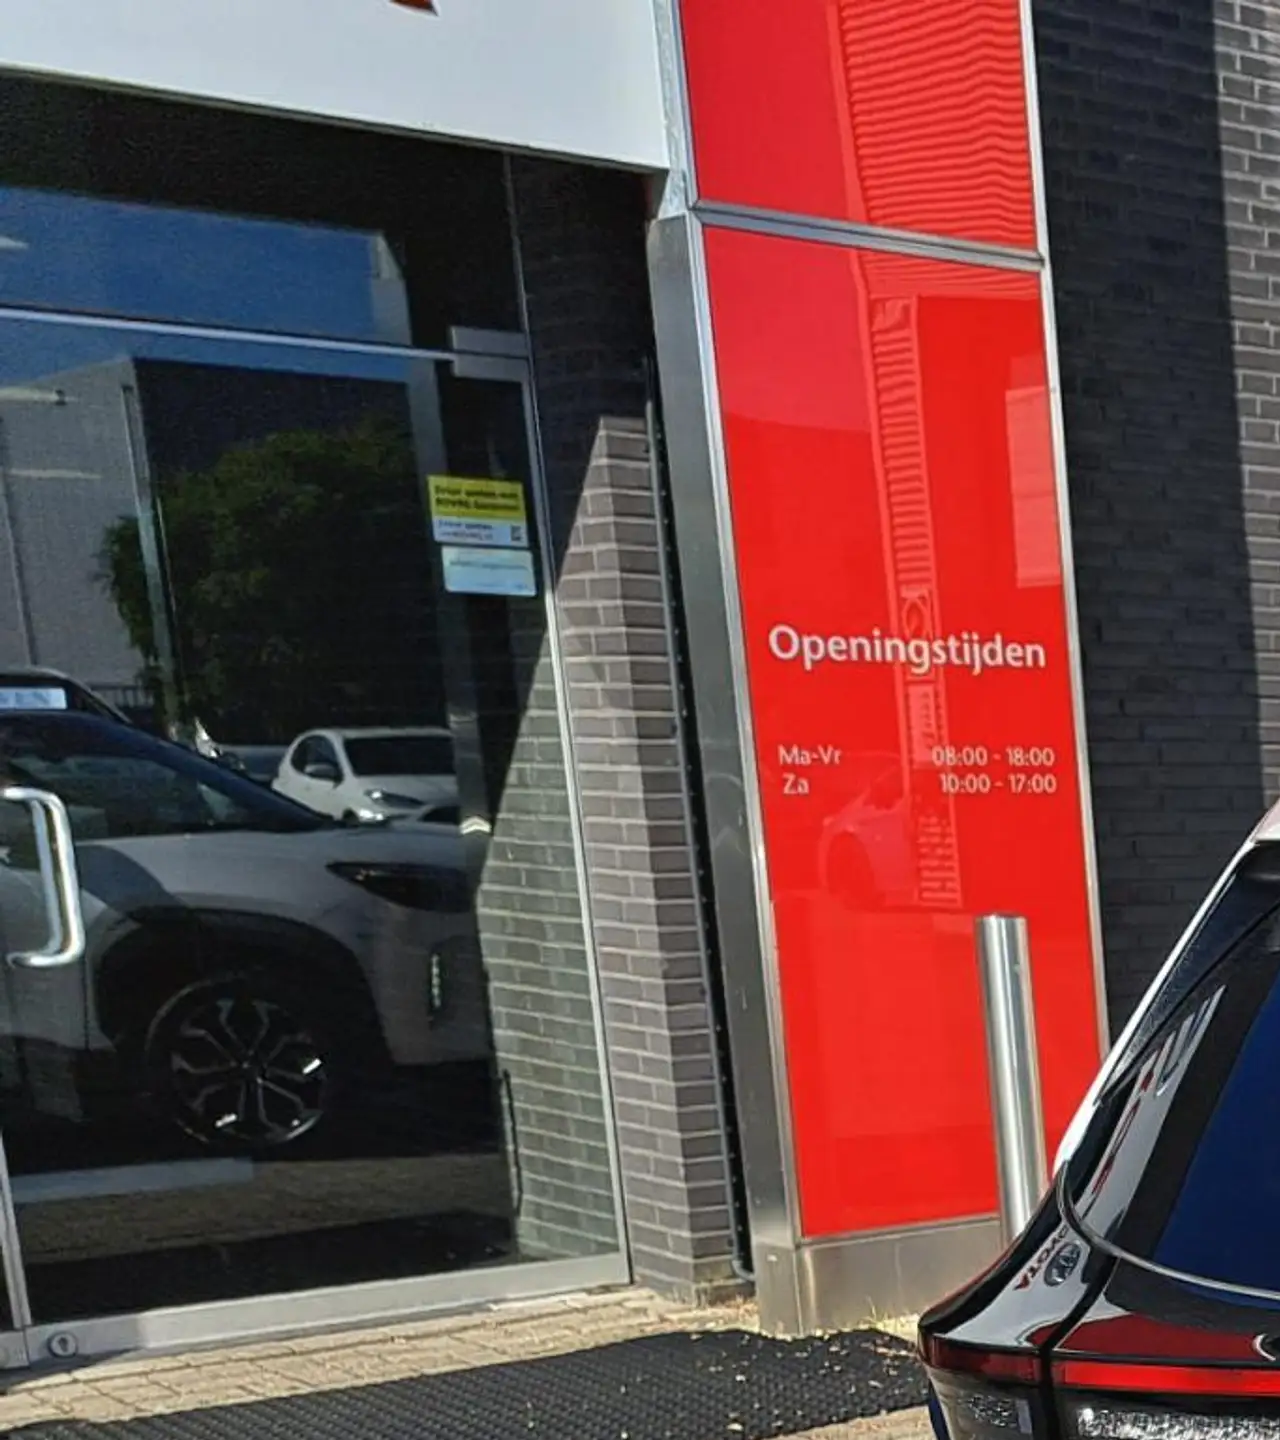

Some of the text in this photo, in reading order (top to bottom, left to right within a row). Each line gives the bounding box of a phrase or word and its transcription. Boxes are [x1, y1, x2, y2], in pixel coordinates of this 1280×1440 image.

[768, 624, 1046, 676] Openingstijden
[777, 744, 841, 766] Ma-Vr
[931, 746, 988, 767] 08:00
[1006, 747, 1055, 767] 18:00
[782, 773, 810, 795] Za
[940, 773, 991, 794] 10:00
[1008, 773, 1057, 794] 17:00
